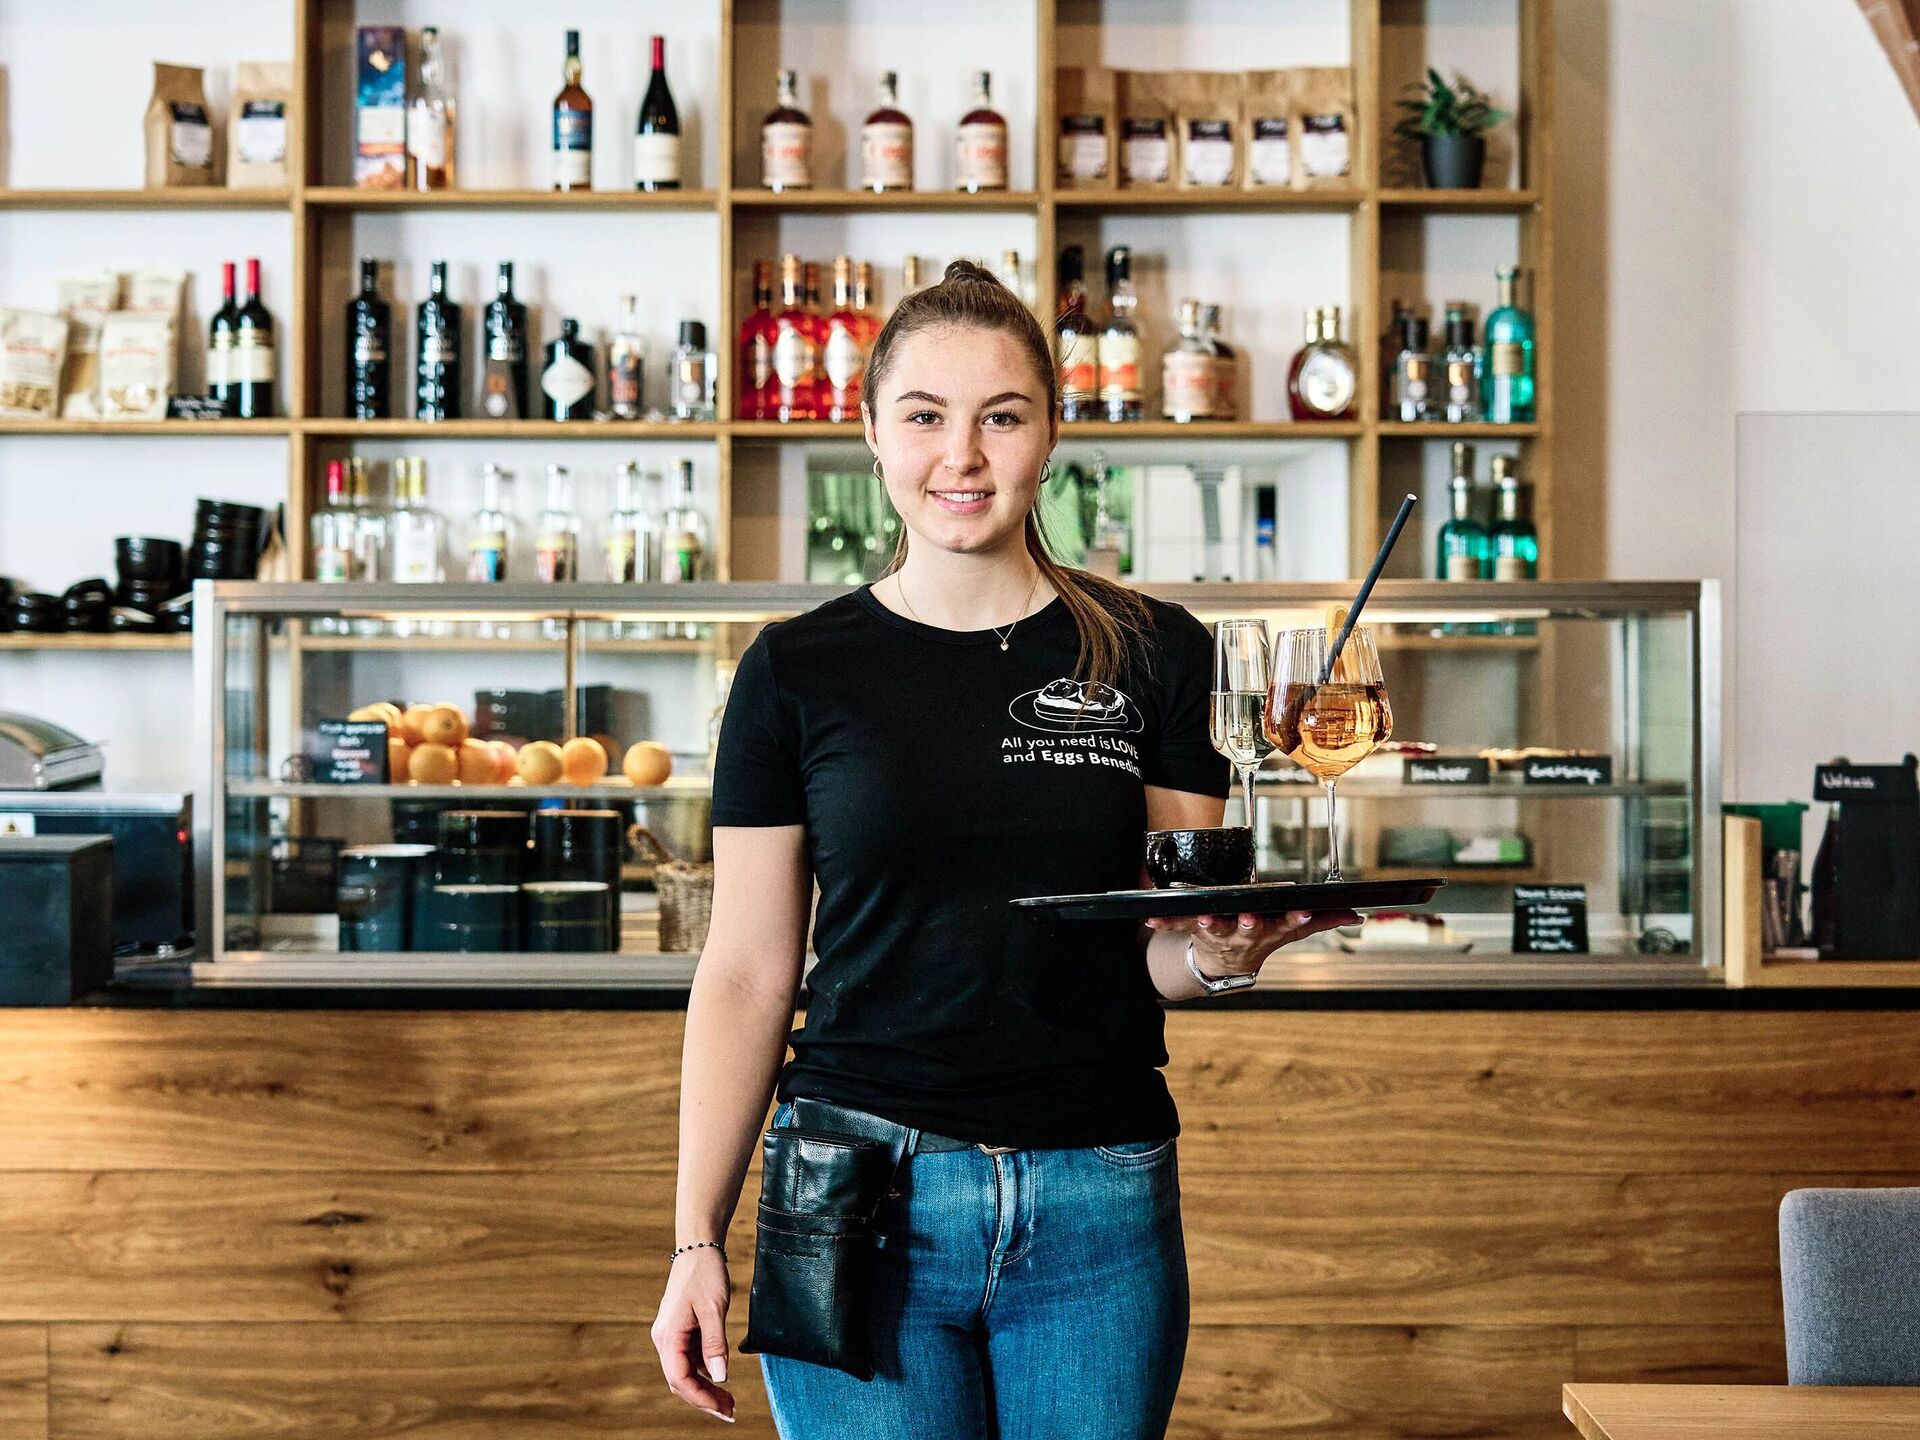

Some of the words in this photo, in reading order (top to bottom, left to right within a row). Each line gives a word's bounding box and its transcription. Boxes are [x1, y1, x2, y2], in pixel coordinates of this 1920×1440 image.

[1001, 737, 1022, 749] All
[1027, 739, 1055, 750] you
[1060, 734, 1096, 747] need
[1099, 735, 1111, 749] is
[1111, 737, 1139, 760] LOVE
[1003, 750, 1035, 763] and
[1041, 749, 1085, 766] Eggs
